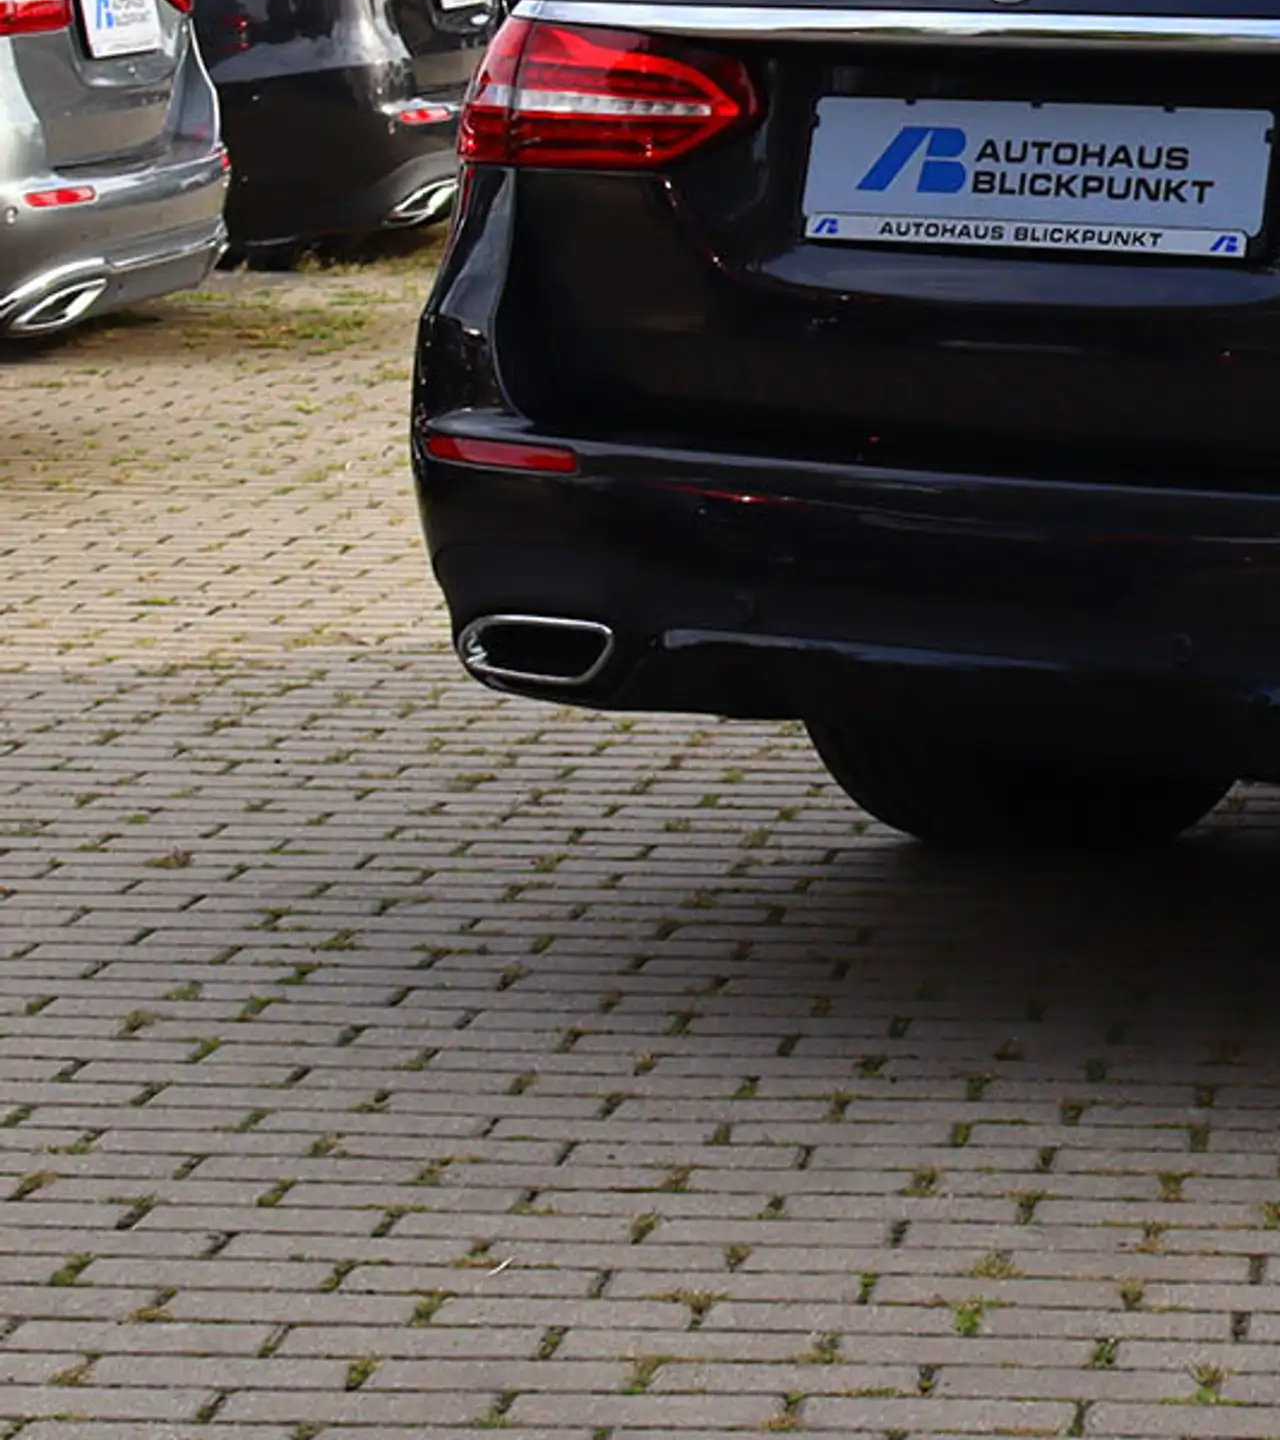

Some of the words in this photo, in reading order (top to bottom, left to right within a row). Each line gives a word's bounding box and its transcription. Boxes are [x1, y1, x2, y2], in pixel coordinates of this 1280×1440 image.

[974, 138, 1190, 171] AUTOHAUS
[970, 170, 1216, 205] BLICKPUNKT
[878, 218, 1004, 241] AUTOHAUS
[1013, 226, 1163, 249] BLICKPUNKT
